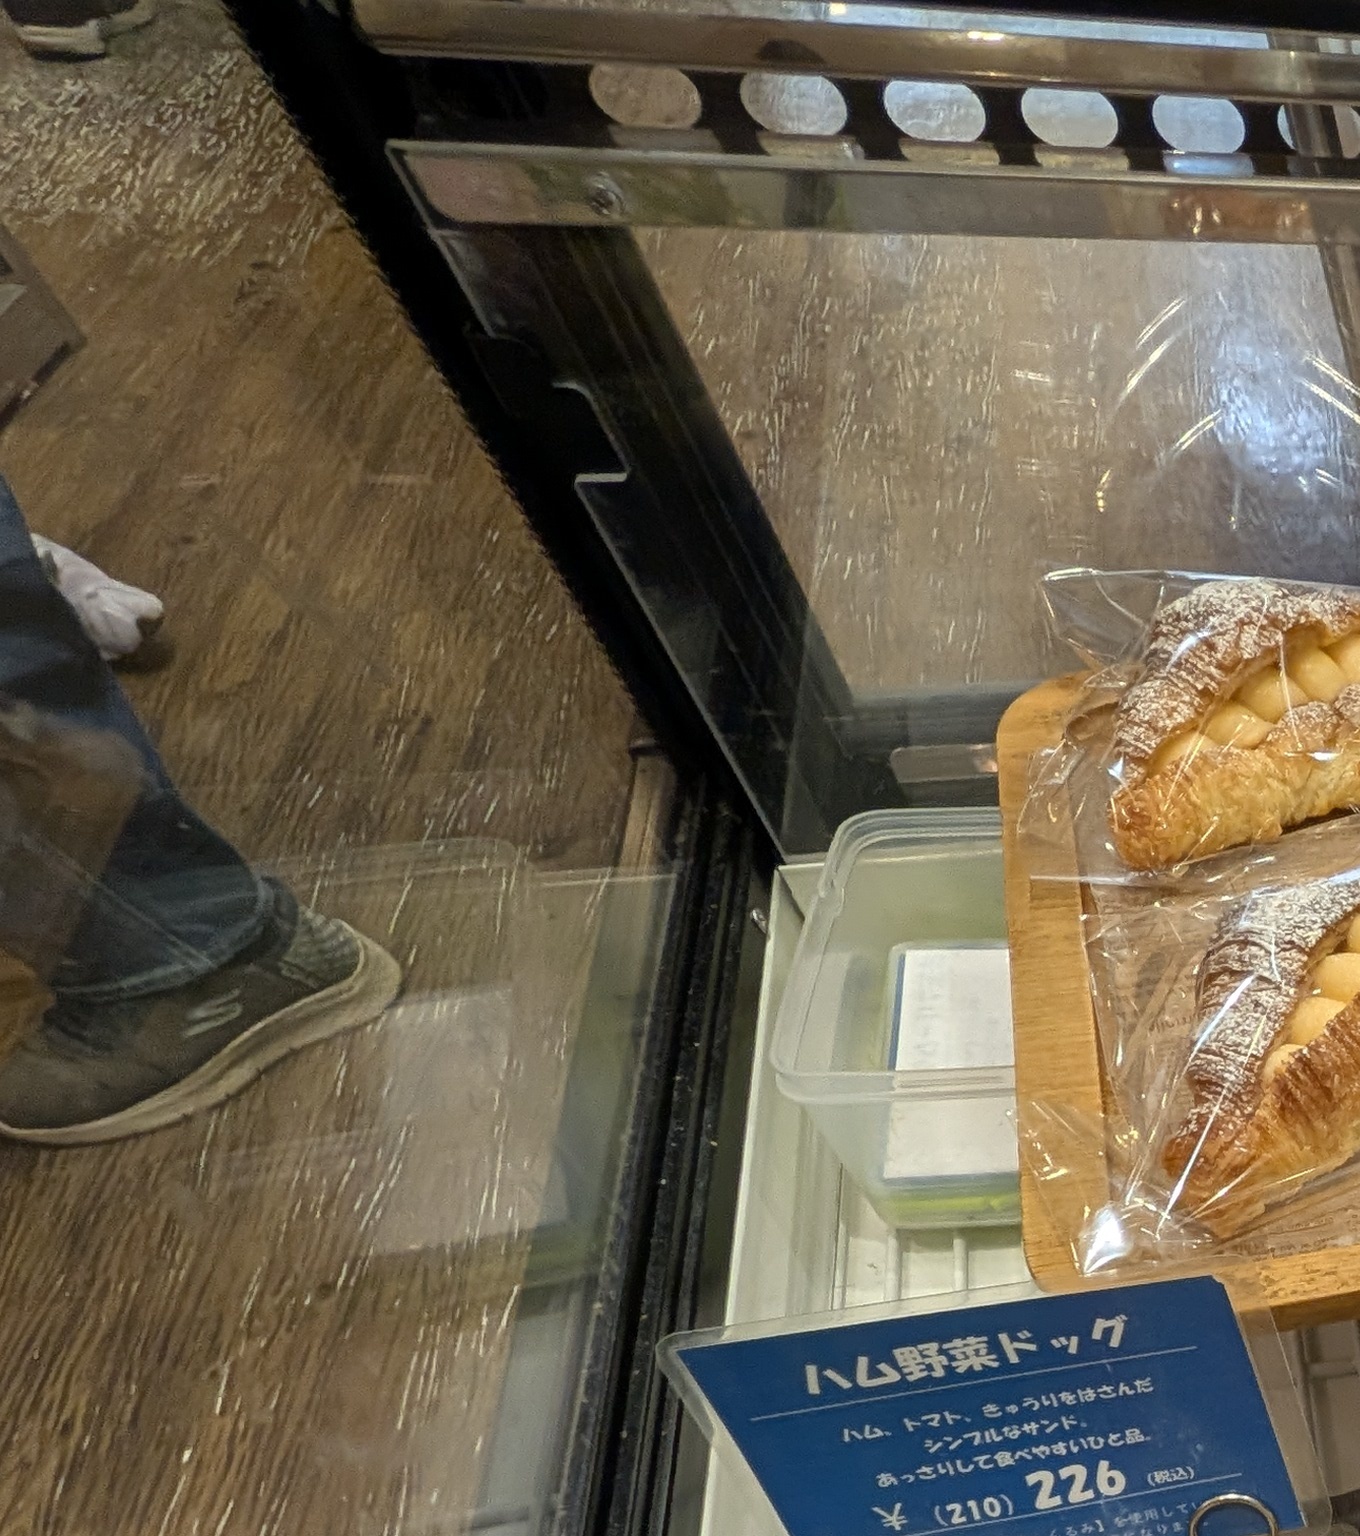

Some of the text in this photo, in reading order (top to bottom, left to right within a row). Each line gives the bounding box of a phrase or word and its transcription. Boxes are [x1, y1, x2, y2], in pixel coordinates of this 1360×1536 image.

[805, 1313, 1129, 1396] ハム野菜ドッグ
[875, 1428, 1153, 1488] あっさりして食べやすいひと品。
[923, 1416, 1088, 1454] シンプルなサンド。
[871, 1460, 1196, 1531] ¥ (210) 226 (税込)
